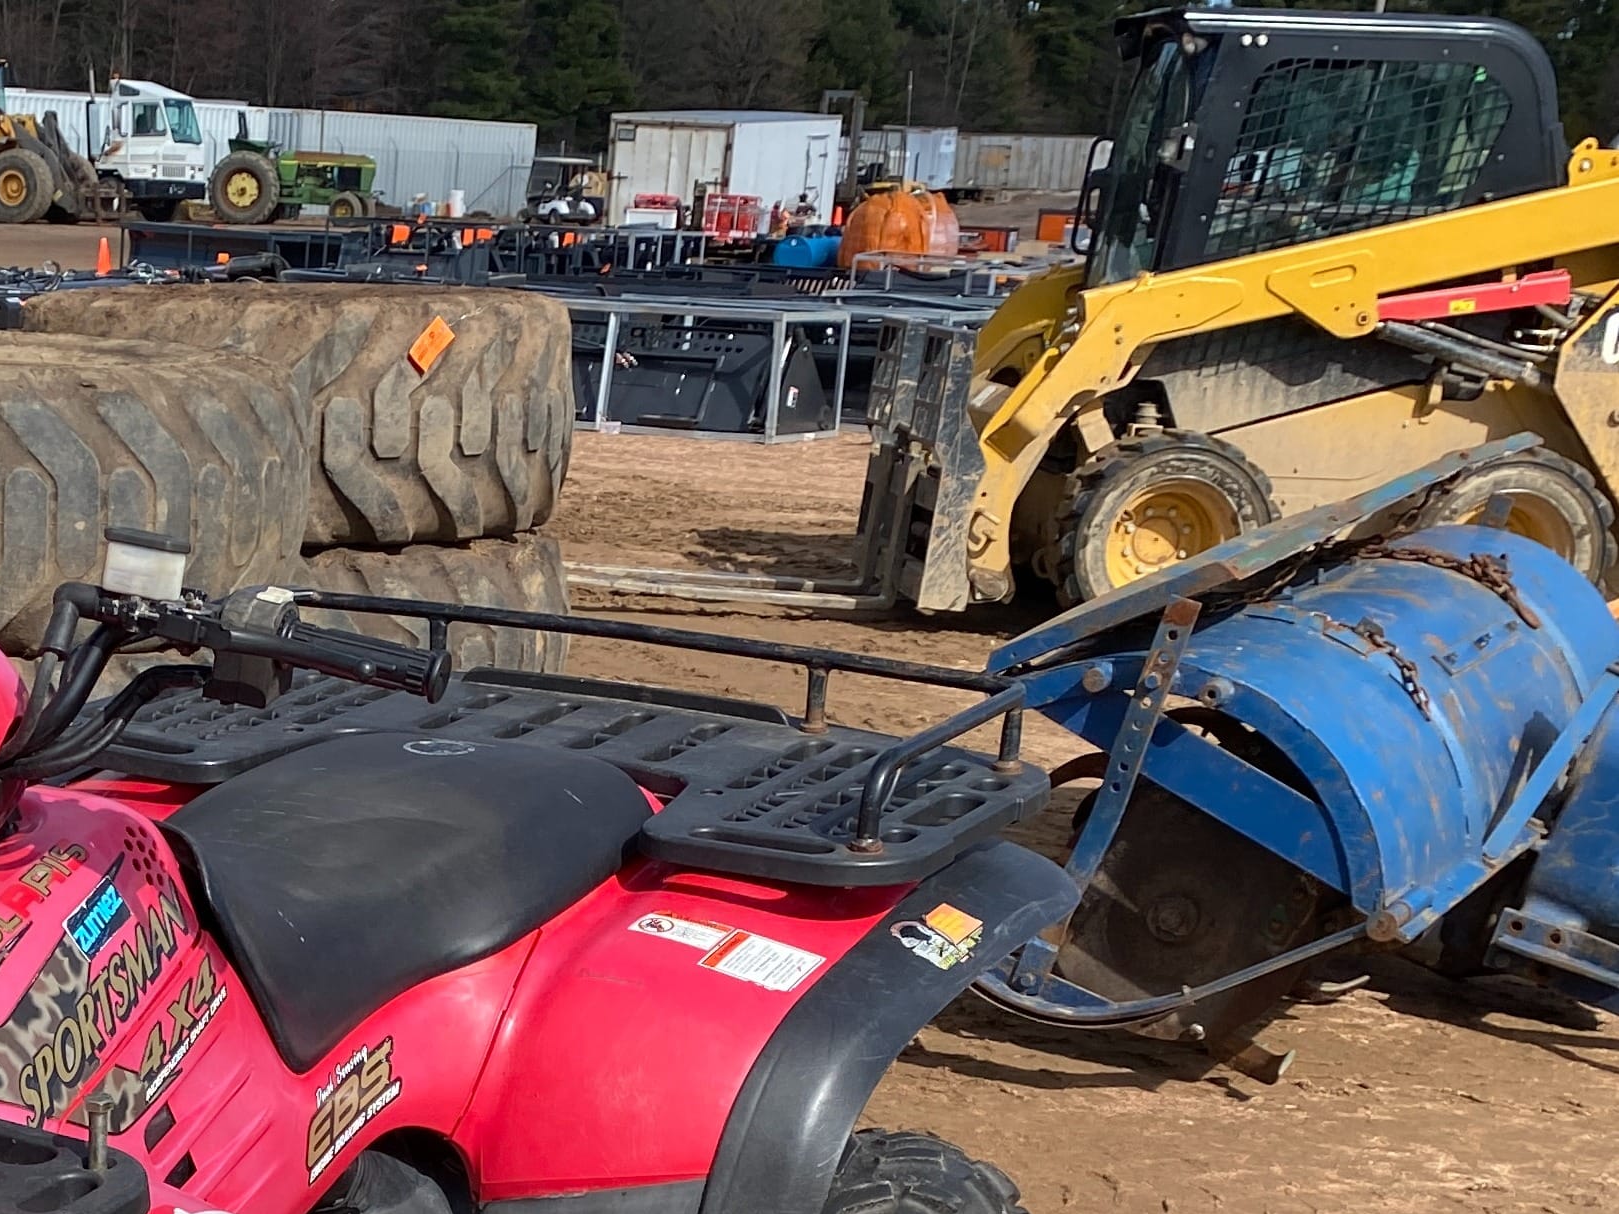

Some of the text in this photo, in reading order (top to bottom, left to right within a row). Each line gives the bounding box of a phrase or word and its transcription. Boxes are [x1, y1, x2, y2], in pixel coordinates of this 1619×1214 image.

[73, 884, 123, 953] zumiez
[19, 876, 189, 1128] SPORTSMAN
[140, 952, 216, 1081] 4X4
[145, 983, 228, 1103] INDEPENDENT SHAFT DRIVE
[307, 1037, 393, 1168] EBS
[335, 1045, 369, 1084] Sensing
[309, 1080, 401, 1184] ENGINE BRAKING SYSTEM
